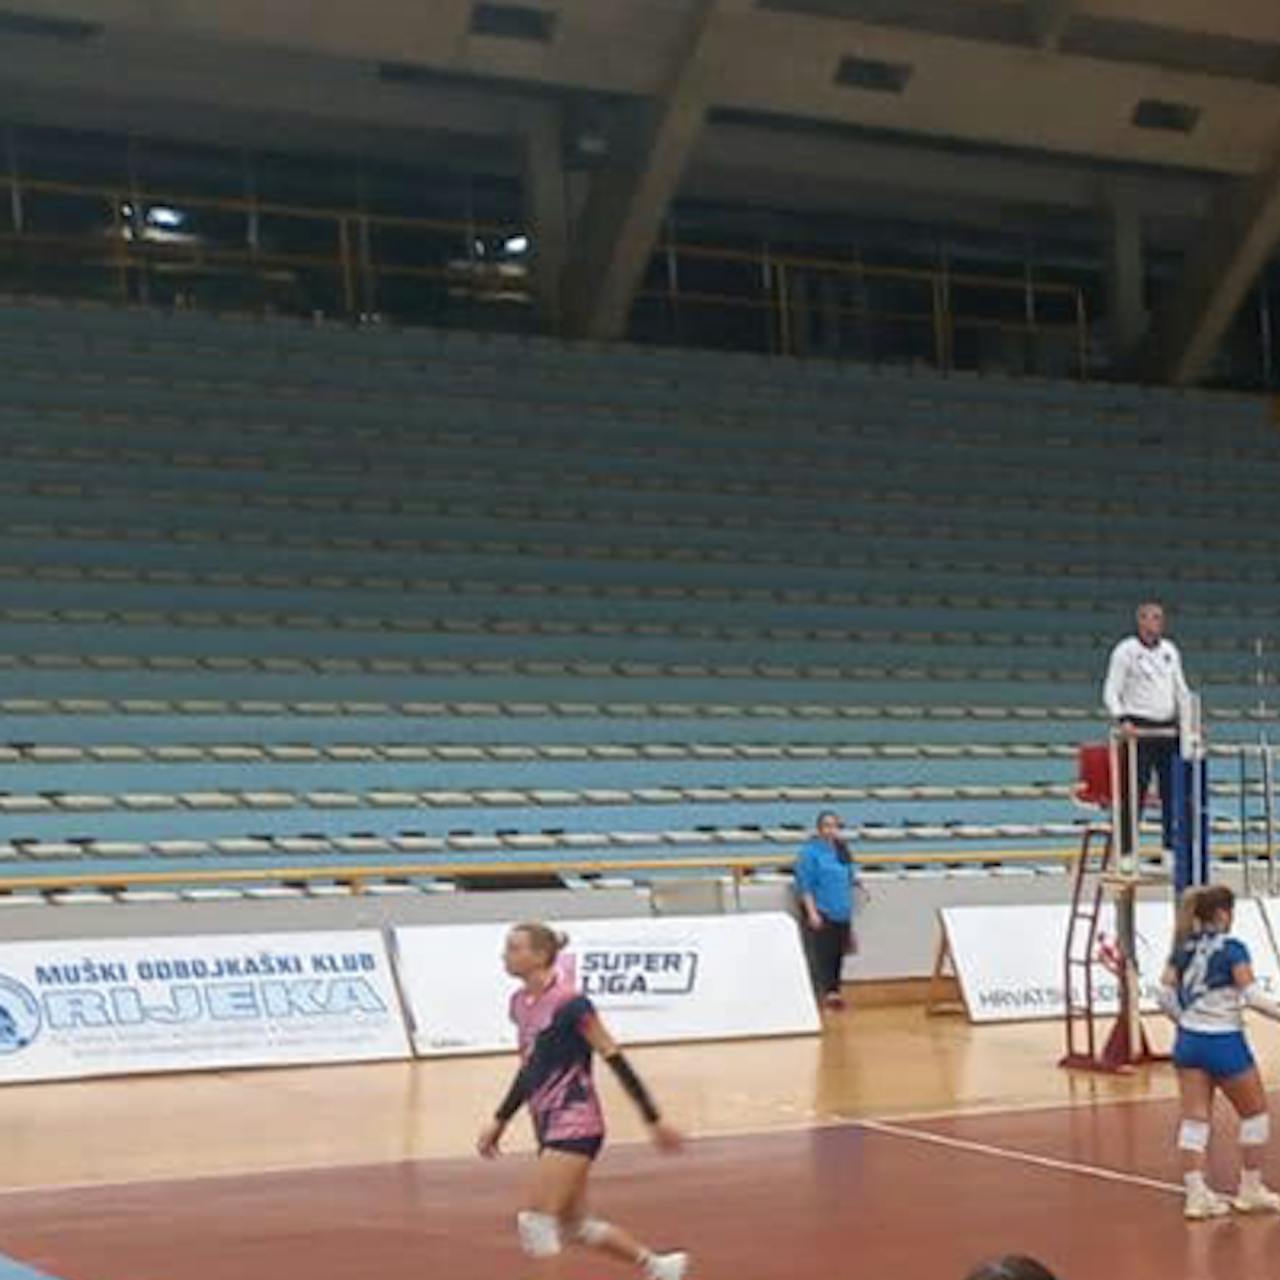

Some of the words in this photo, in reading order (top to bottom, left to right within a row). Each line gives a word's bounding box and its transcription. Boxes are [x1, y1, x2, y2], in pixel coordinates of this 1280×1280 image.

[35, 957, 128, 984] MUŠKI
[137, 951, 302, 981] ODBOJKAŠKI
[312, 953, 375, 972] KLUB
[582, 952, 683, 973] SUPER
[582, 975, 648, 995] LIGA
[43, 977, 388, 1028] RIJEKA
